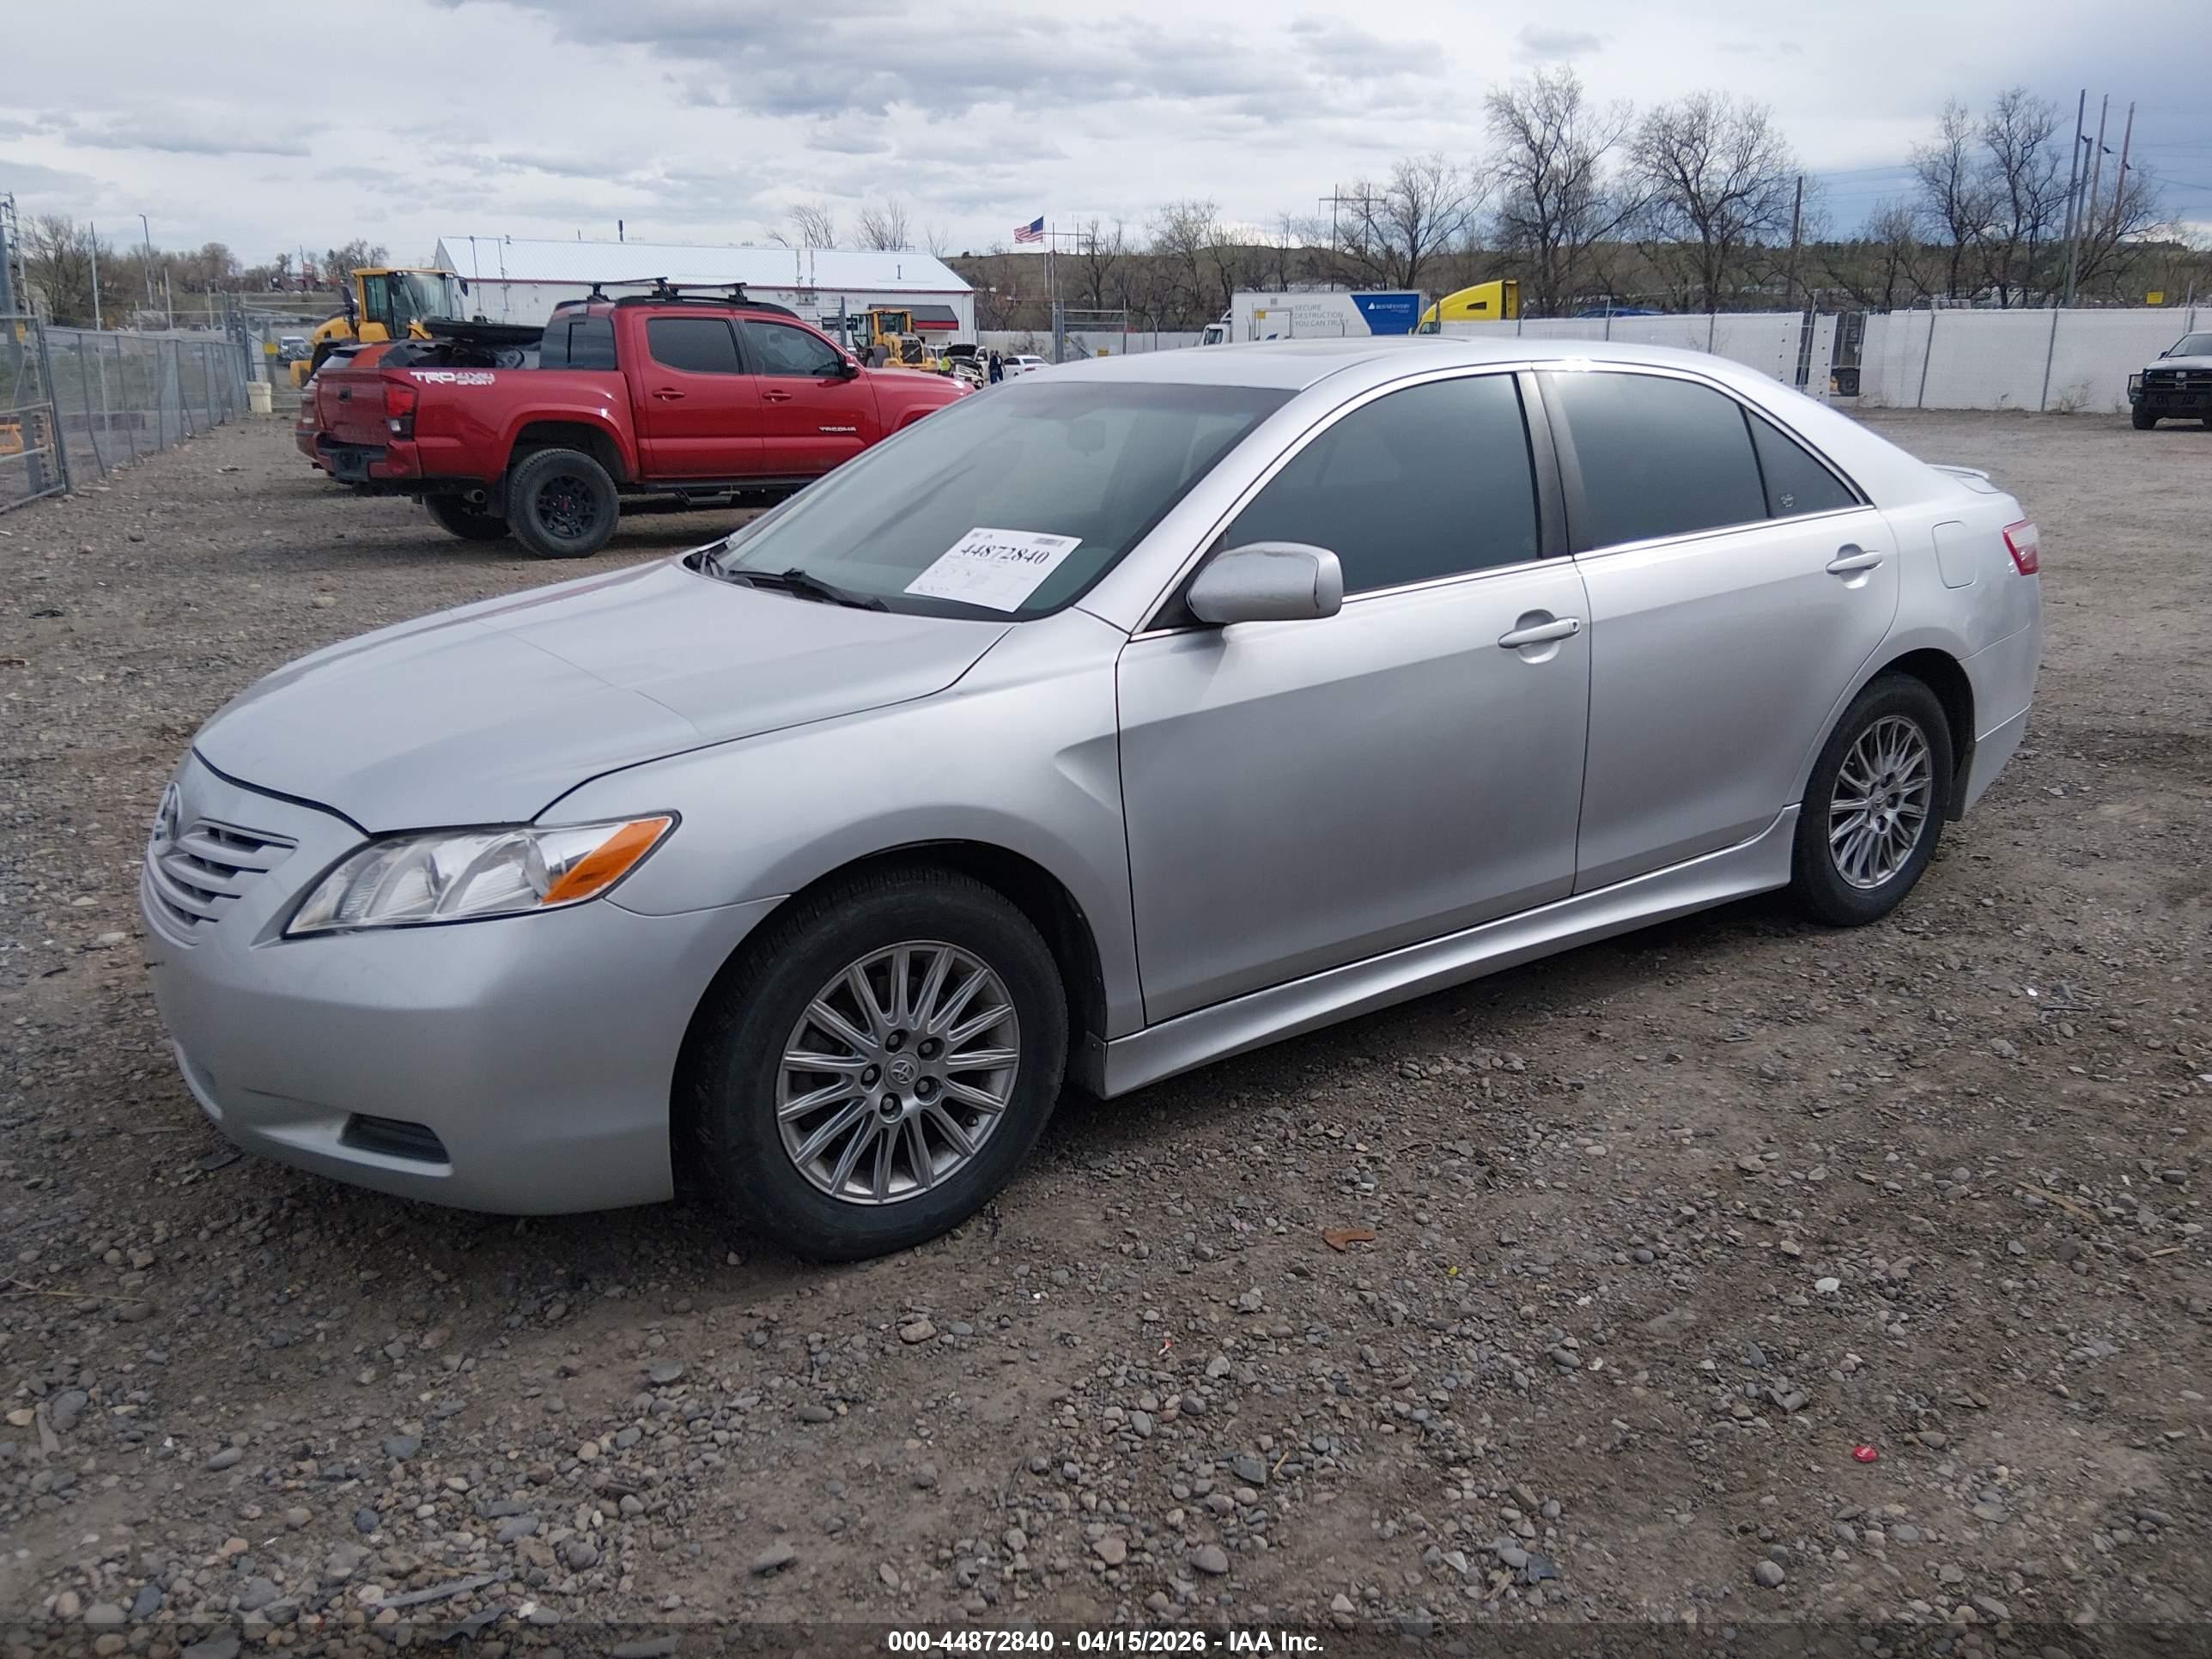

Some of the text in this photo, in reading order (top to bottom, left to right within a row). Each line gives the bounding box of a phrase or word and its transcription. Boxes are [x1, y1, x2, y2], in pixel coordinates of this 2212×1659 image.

[1294, 311, 1344, 319] DESTRUCTION
[410, 371, 456, 385] TRD
[961, 544, 1050, 565] 44872840
